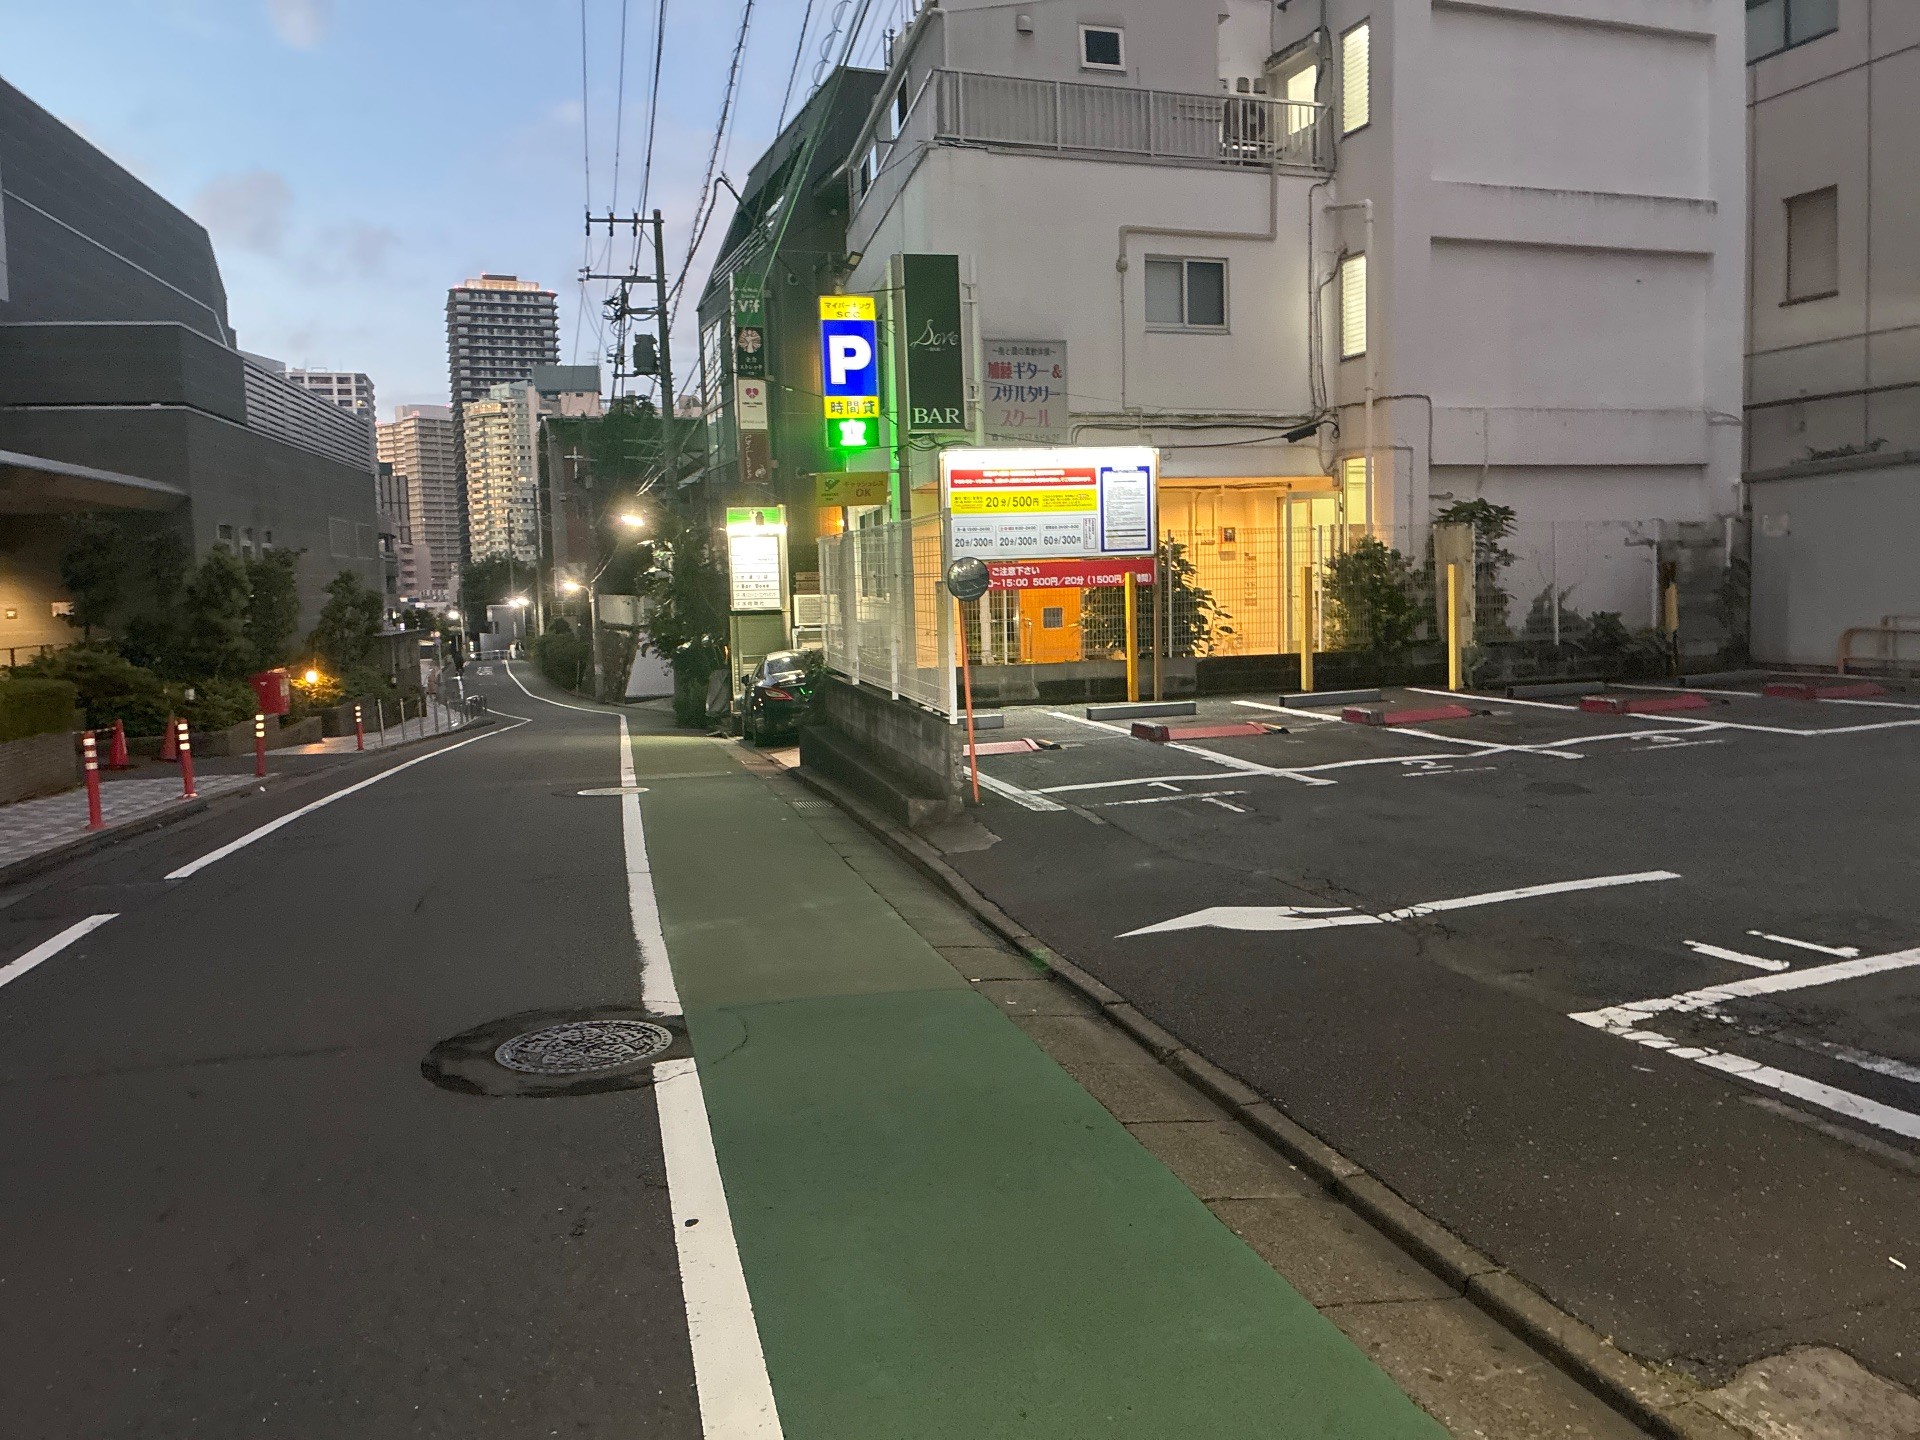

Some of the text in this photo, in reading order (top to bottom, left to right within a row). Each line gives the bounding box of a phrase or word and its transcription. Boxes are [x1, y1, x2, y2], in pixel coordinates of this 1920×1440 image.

[737, 299, 760, 313] Vif
[828, 335, 872, 384] P
[830, 400, 875, 415] 時間貸
[913, 407, 961, 423] BAR
[1000, 409, 1050, 428] スクール
[856, 488, 871, 497] OK
[985, 496, 1039, 508] 20分/500円
[955, 537, 993, 548] 20分/300円
[1000, 536, 1038, 547] 20分/300円
[1044, 535, 1081, 545] 60分/300円
[991, 566, 1040, 576] ご注意下さい
[1033, 576, 1083, 587] 500円/20分
[1401, 760, 1454, 769] 2
